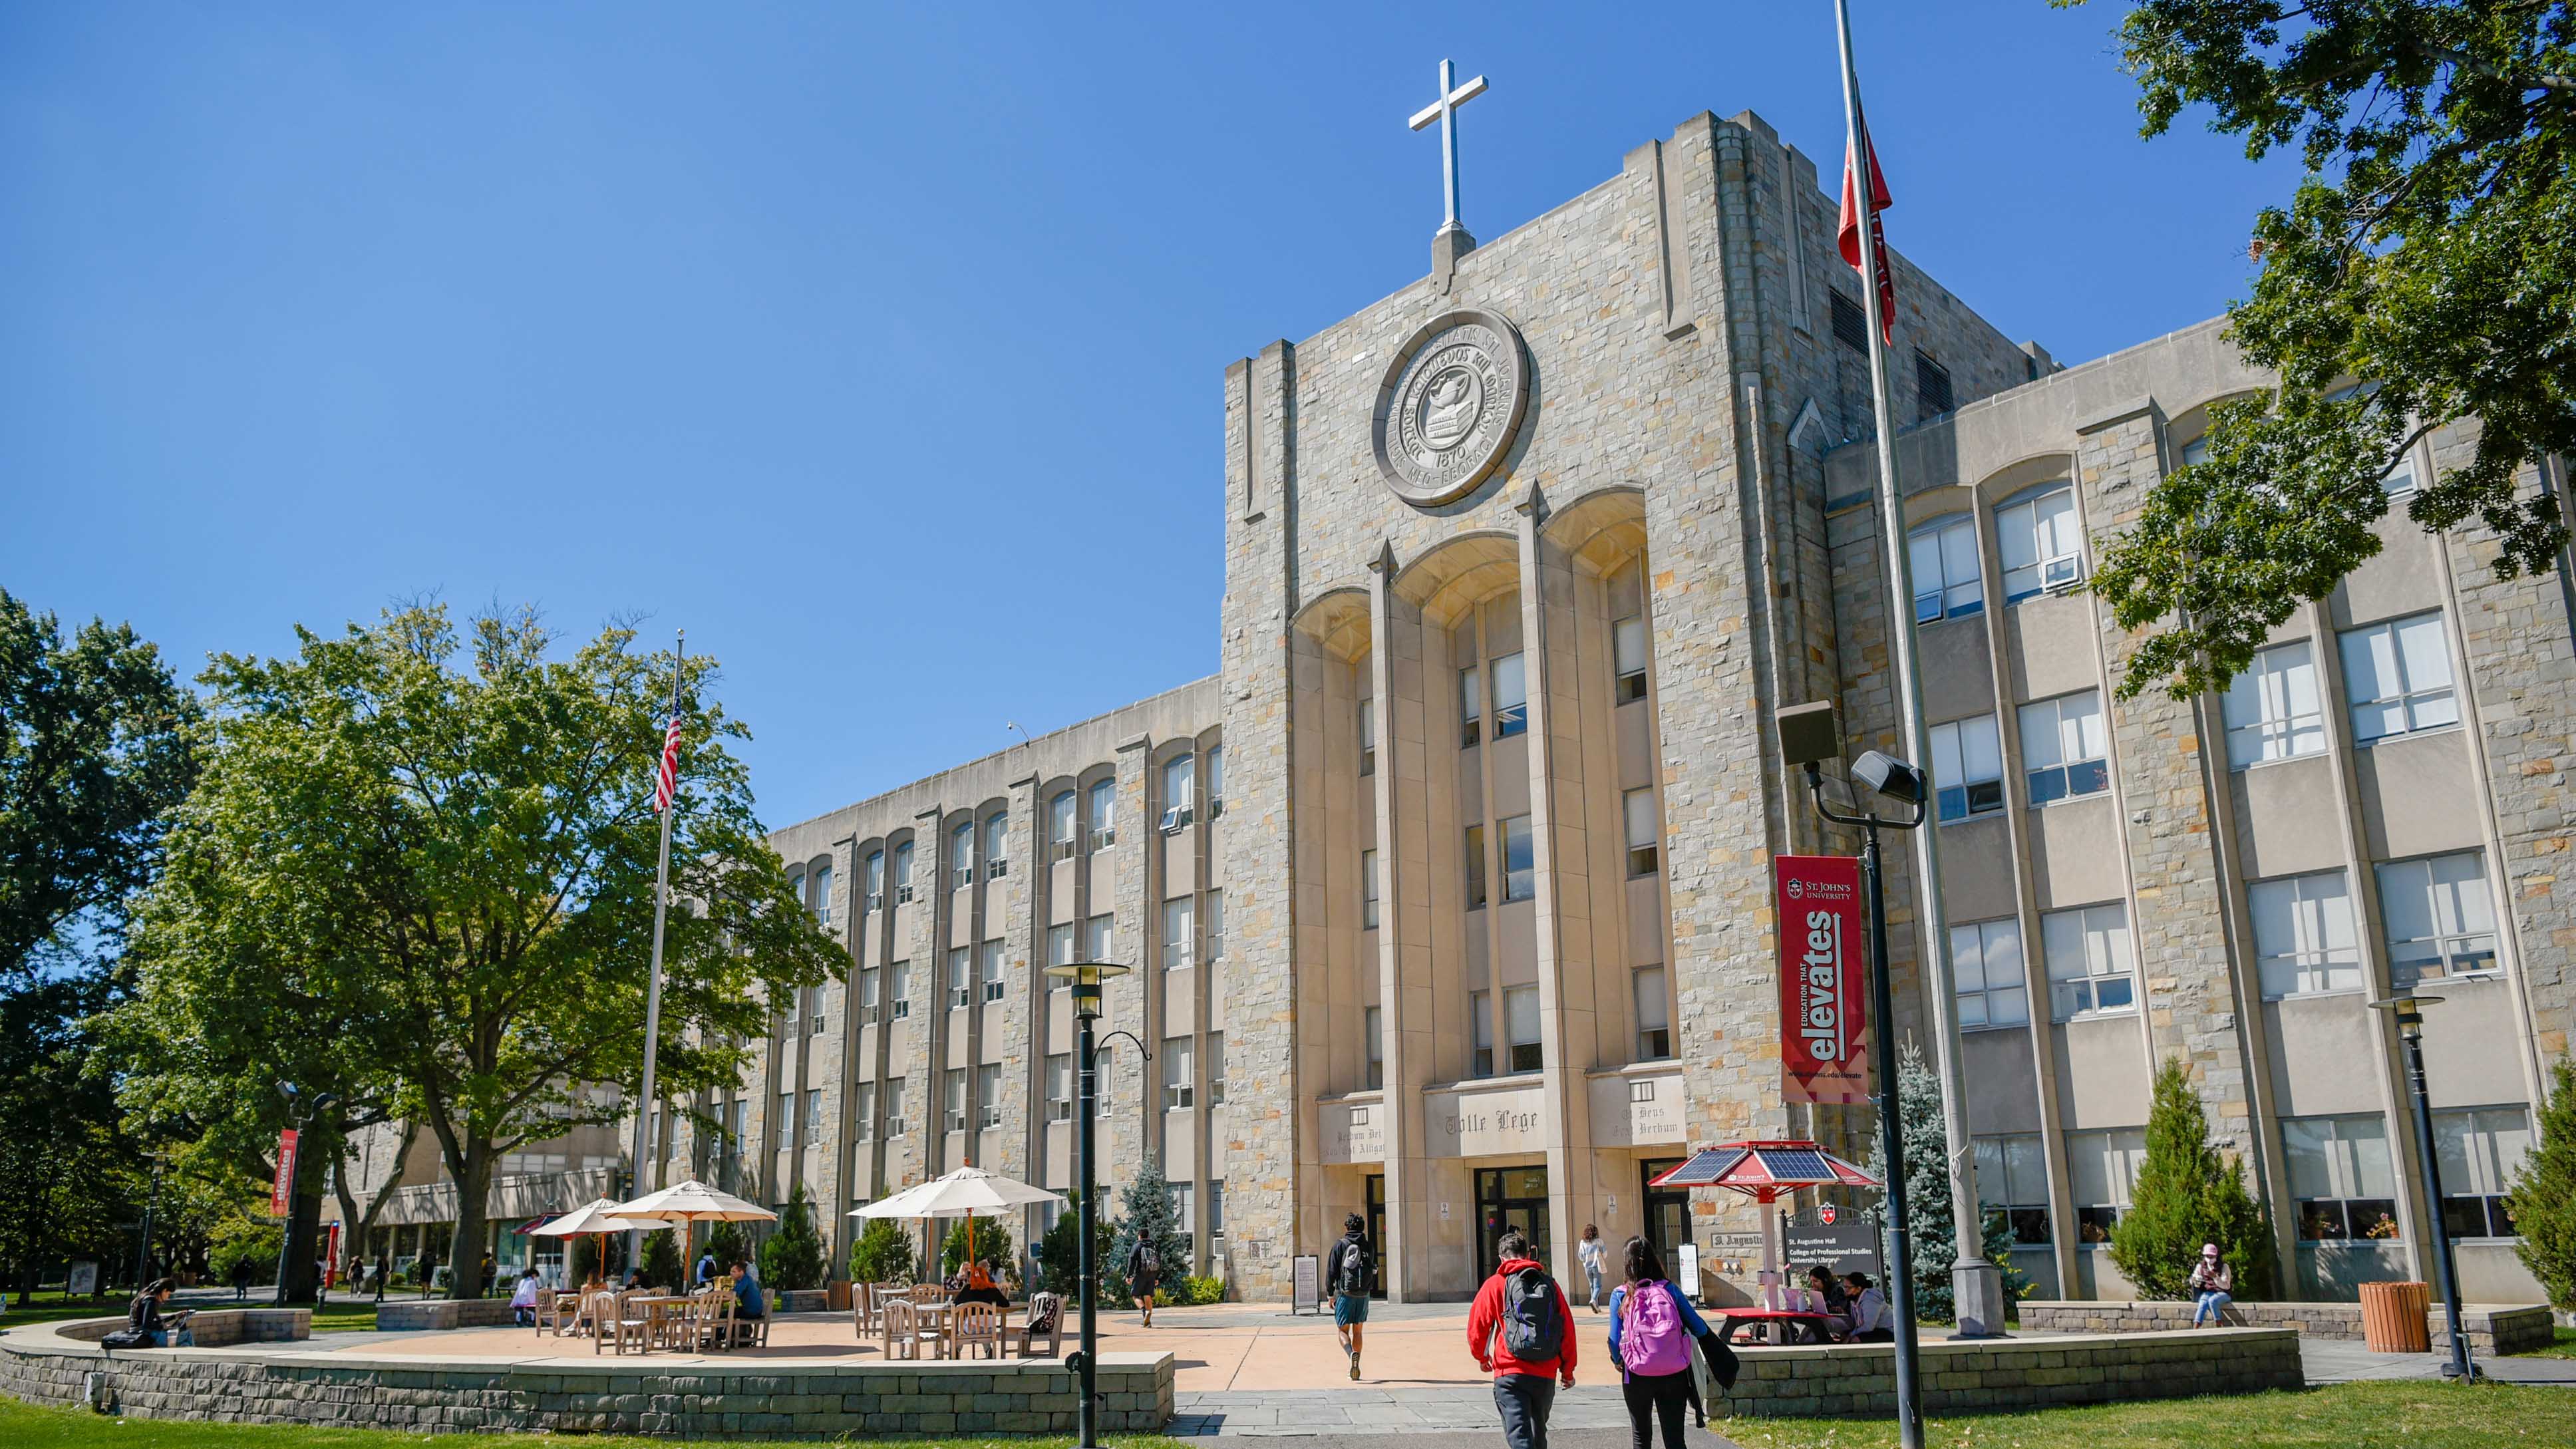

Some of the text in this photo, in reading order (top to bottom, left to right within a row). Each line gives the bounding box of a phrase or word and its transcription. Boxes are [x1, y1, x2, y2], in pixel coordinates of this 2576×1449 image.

[1436, 446, 1466, 468] 1870
[1800, 910, 1836, 1061] elevates
[1444, 1110, 1538, 1135] Tolle Lege
[1639, 1106, 1665, 1118] Deus
[276, 1149, 292, 1202] elevates
